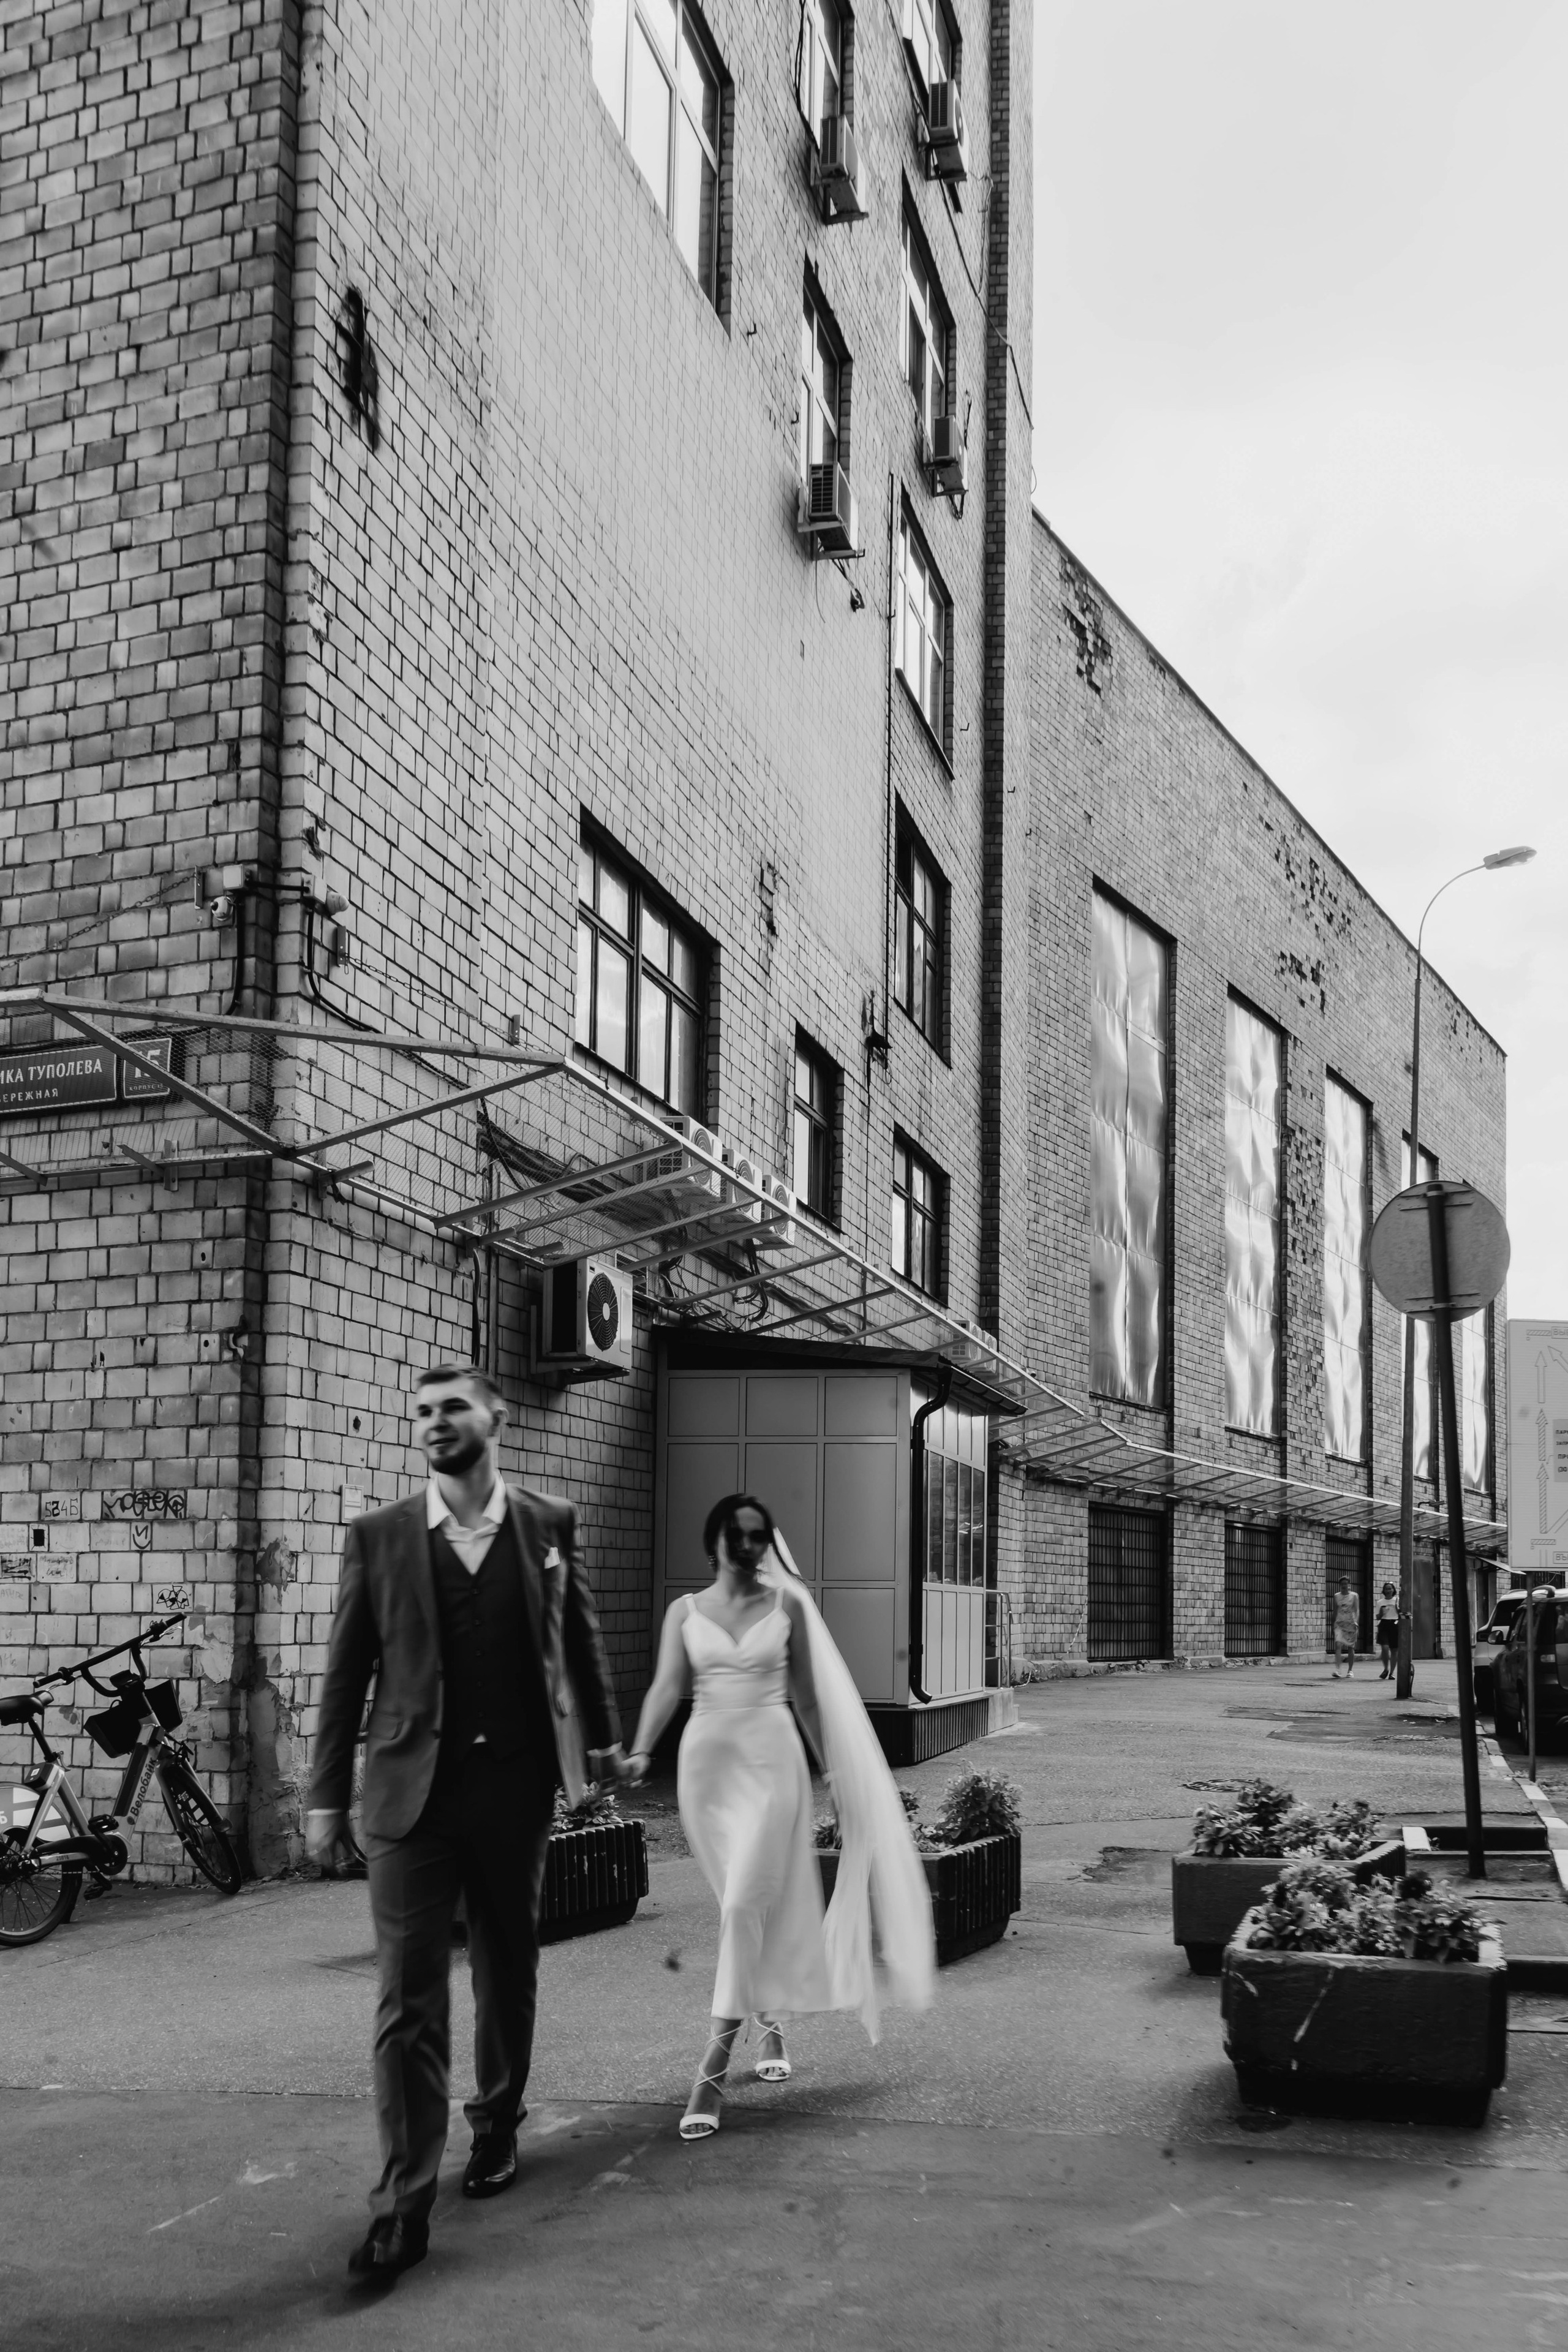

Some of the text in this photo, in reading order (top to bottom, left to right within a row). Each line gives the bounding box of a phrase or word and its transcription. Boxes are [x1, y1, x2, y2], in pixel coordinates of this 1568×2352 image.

[28, 1058, 103, 1081] ТУПОЛЕВА
[0, 1088, 58, 1103] ЕРЕЖНАЯ
[130, 1757, 158, 1817] Велобайк
